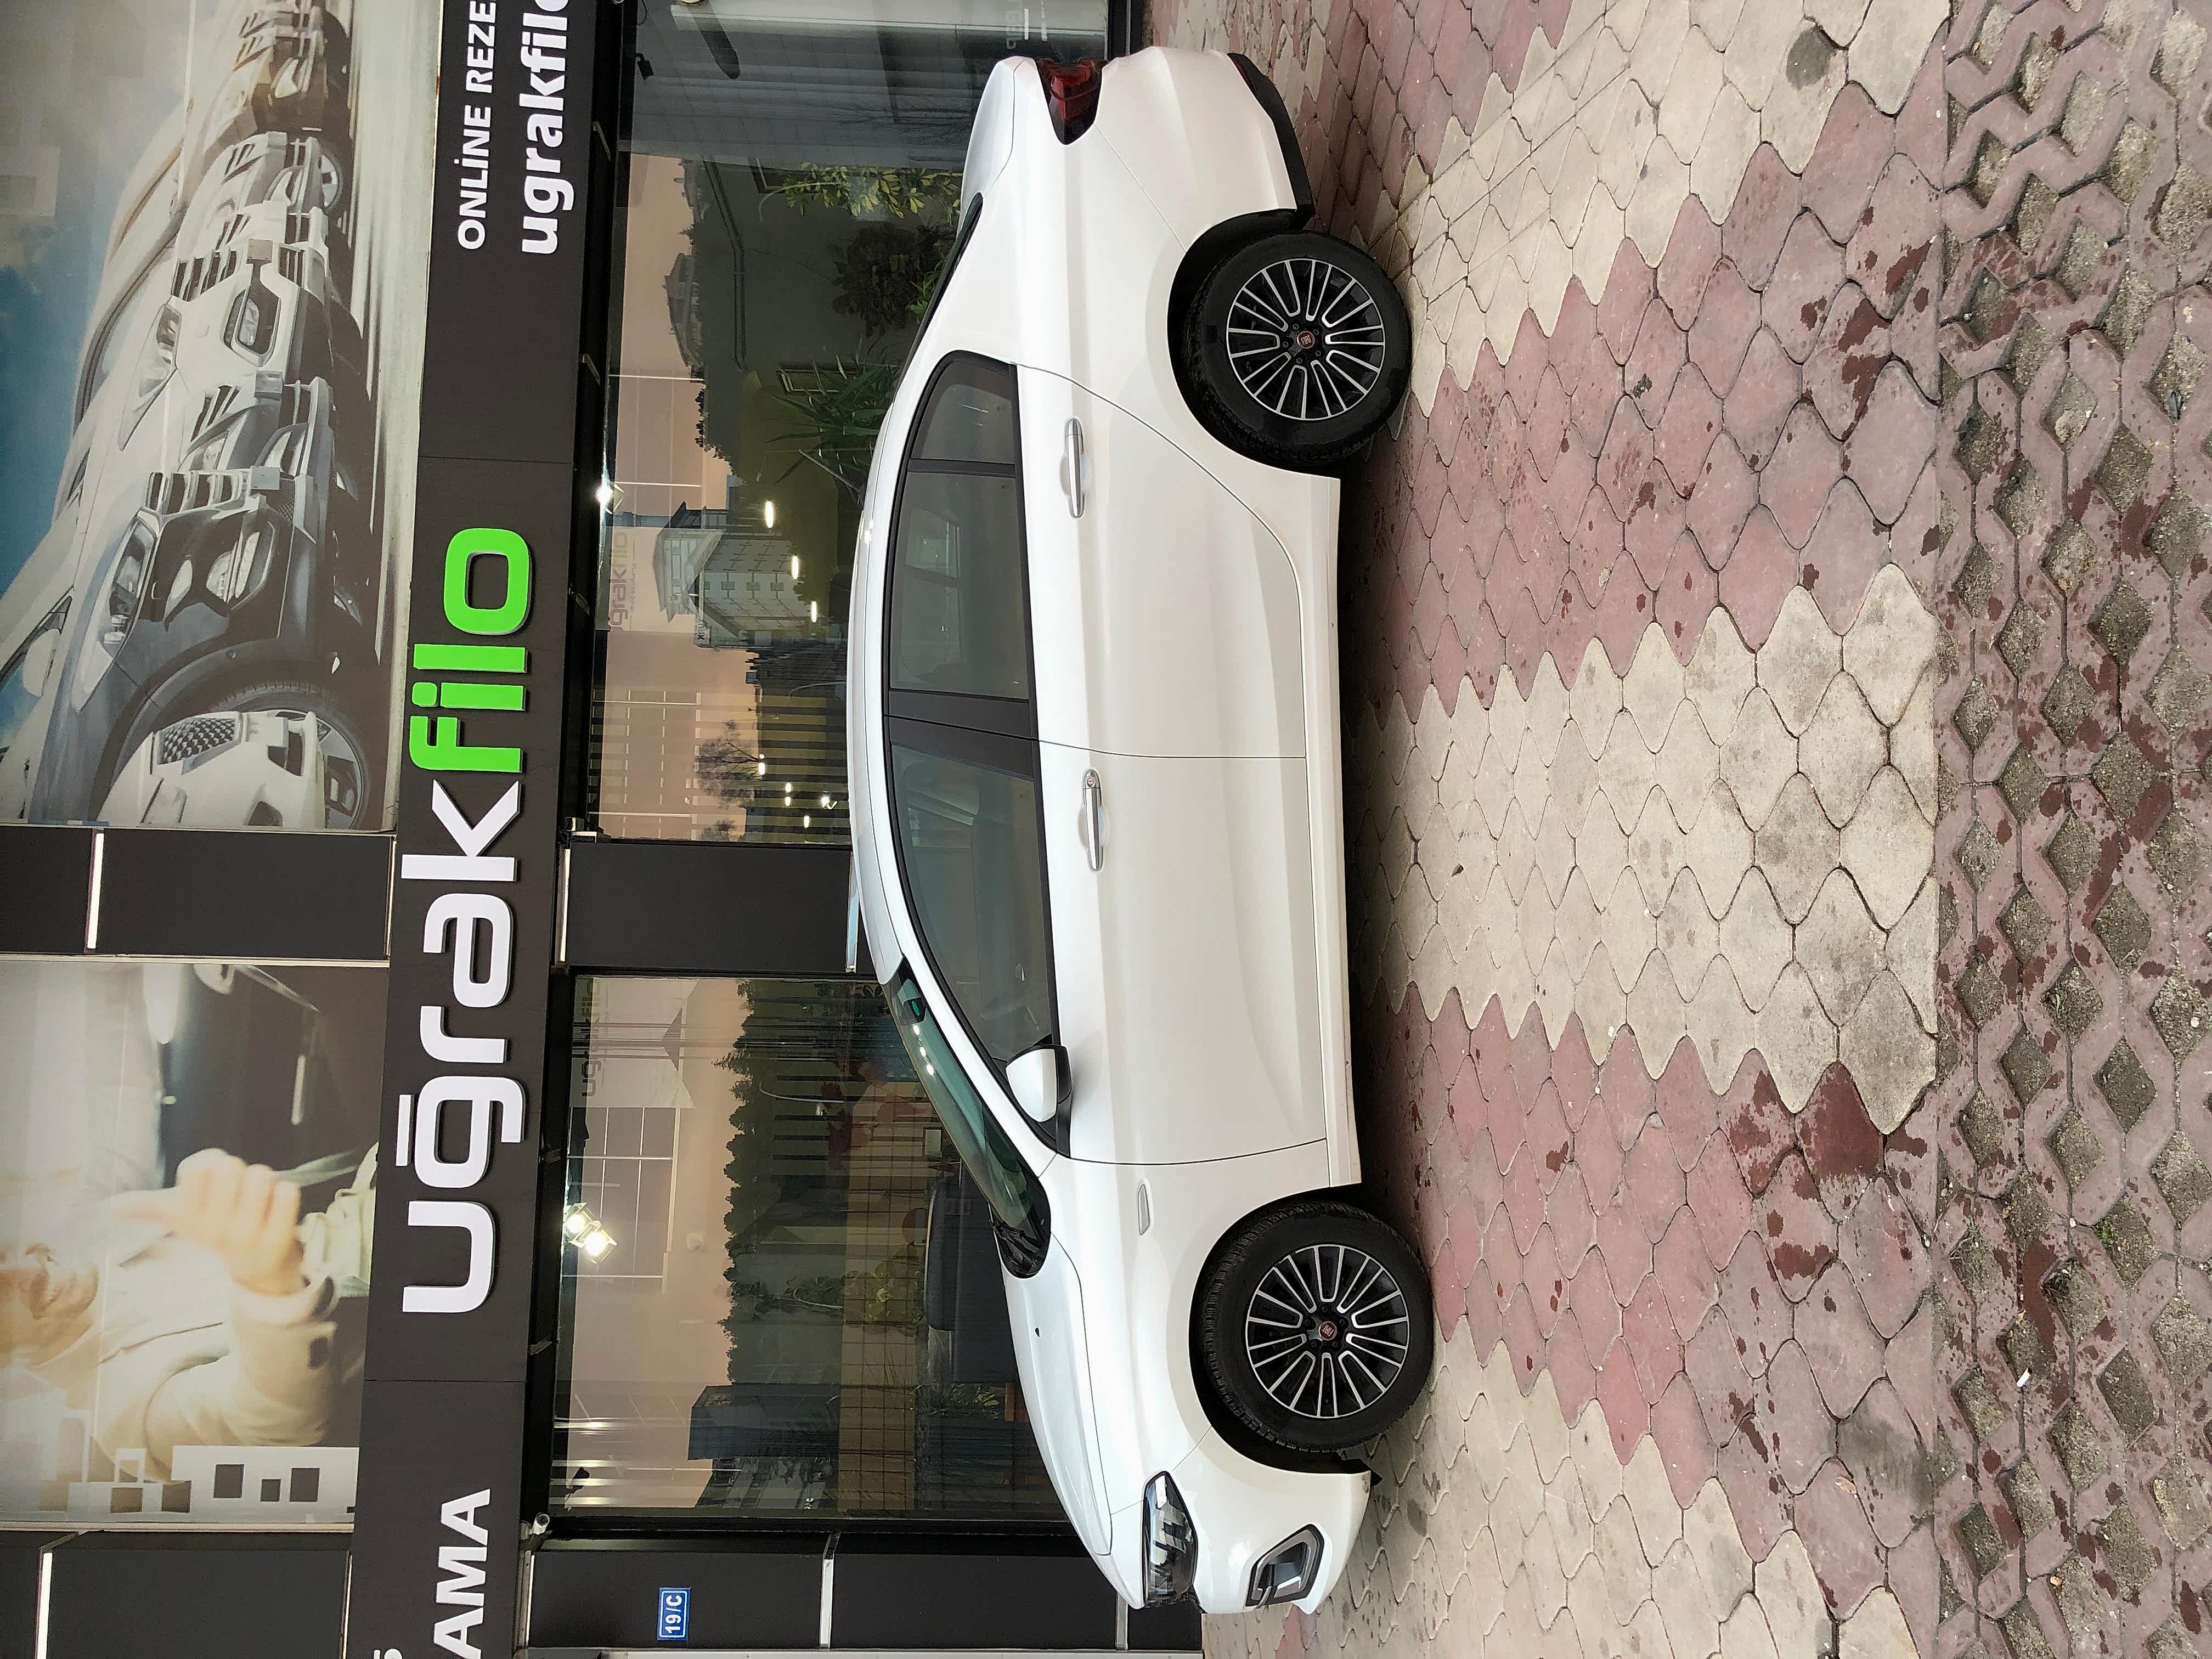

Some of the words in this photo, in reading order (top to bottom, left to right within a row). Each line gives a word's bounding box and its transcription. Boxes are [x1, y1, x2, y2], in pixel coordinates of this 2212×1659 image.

[466, 0, 496, 93] REZE
[454, 105, 491, 250] ONLİNE
[664, 1595, 682, 1634] 19/C
